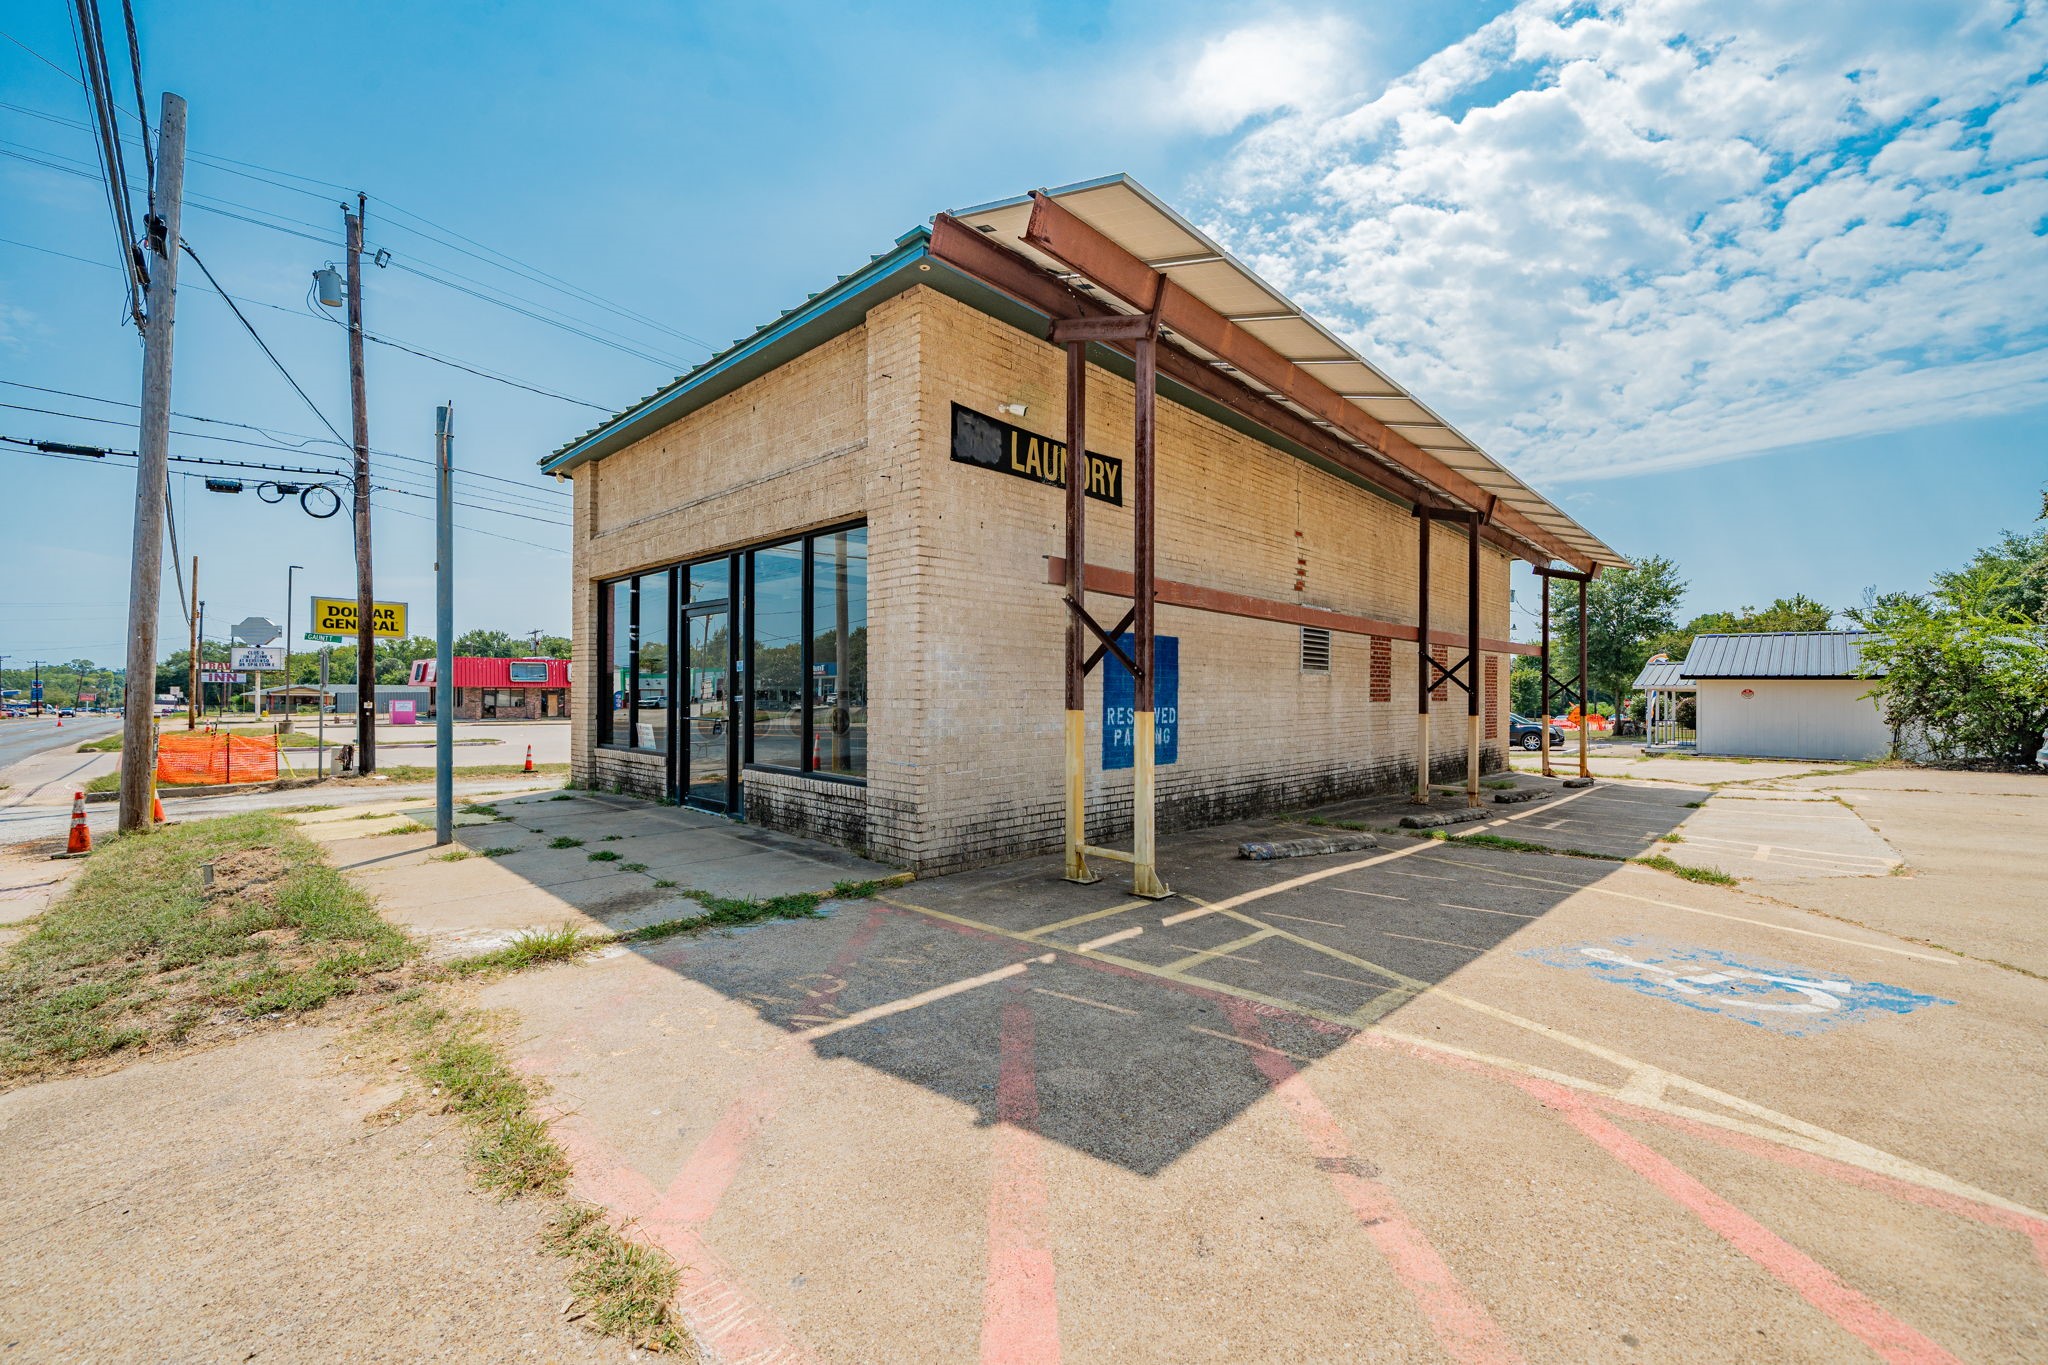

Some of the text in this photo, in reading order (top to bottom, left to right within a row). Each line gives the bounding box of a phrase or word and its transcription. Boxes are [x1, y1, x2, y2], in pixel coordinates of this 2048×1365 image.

[327, 605, 395, 620] DOLAR
[322, 617, 399, 632] GENAL
[208, 673, 238, 682] INN
[1107, 707, 1176, 725] RESVED
[1113, 727, 1171, 747] PANG
